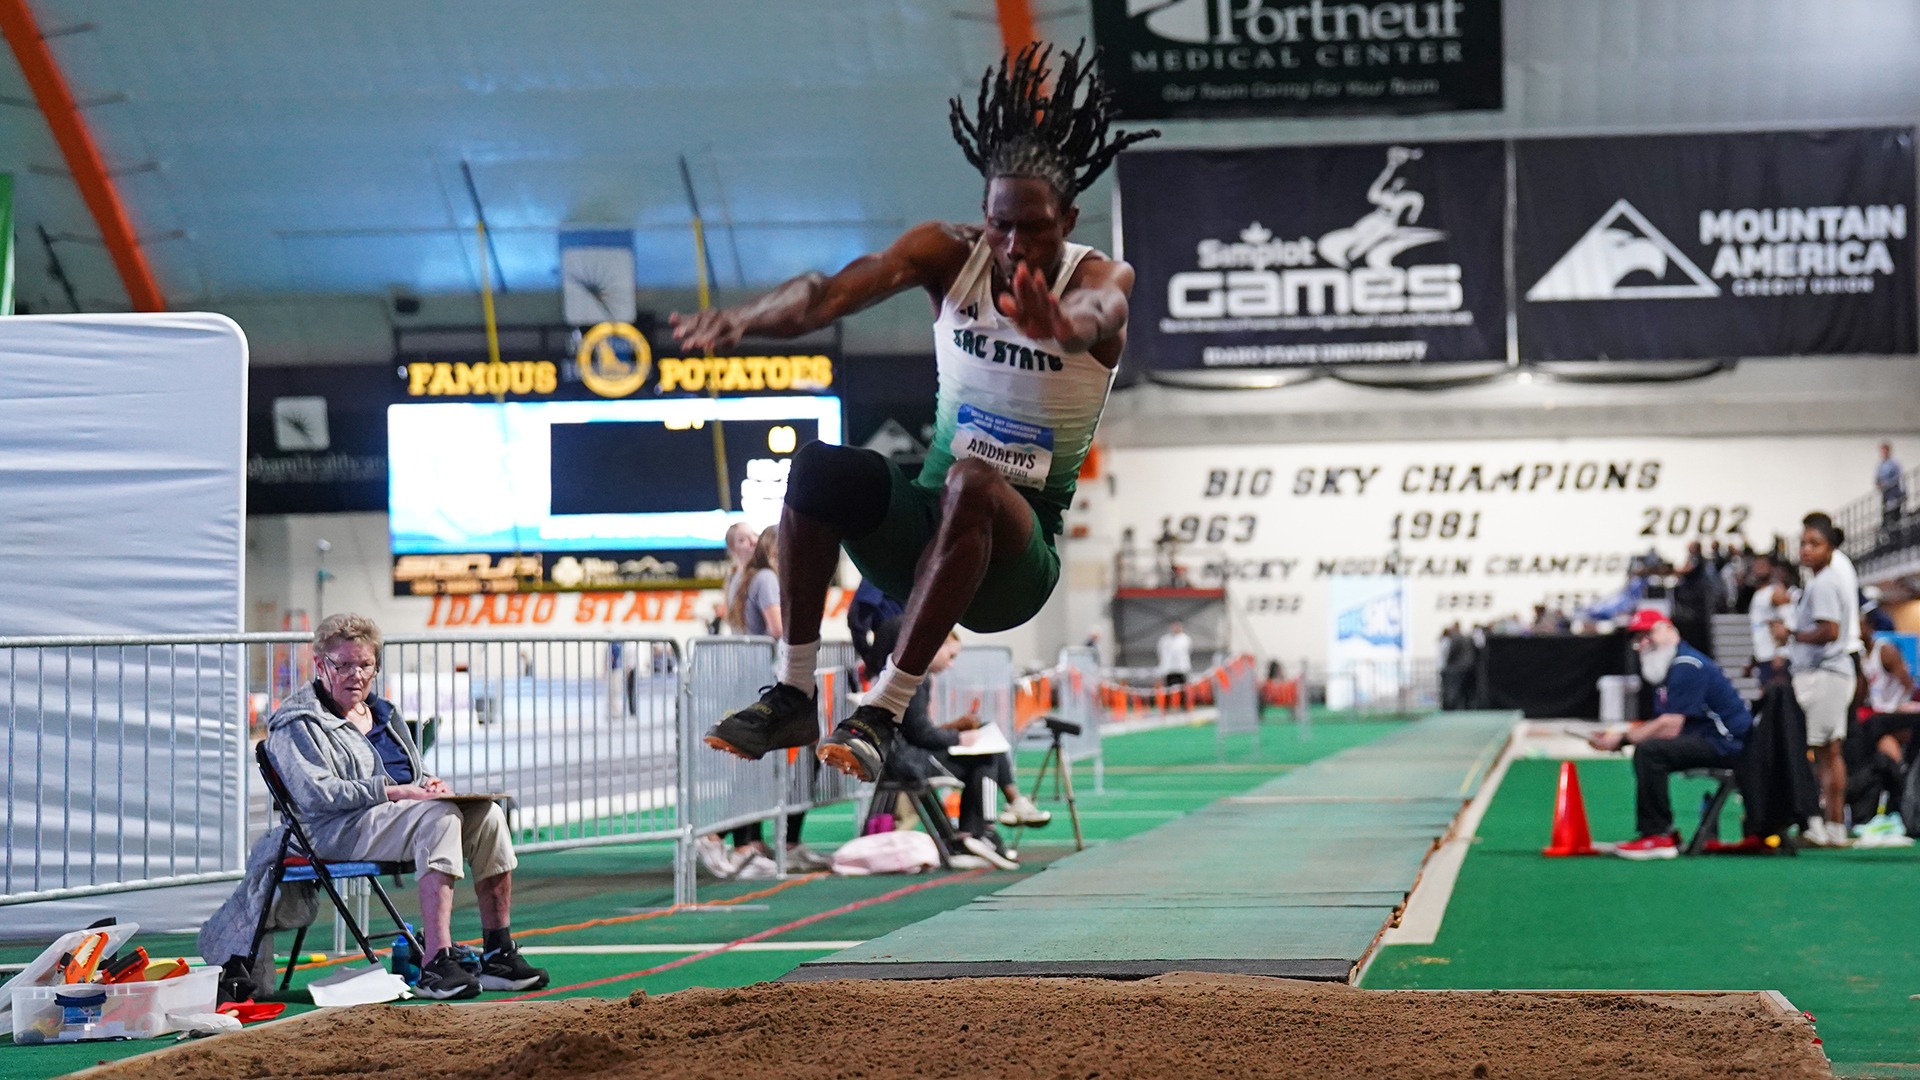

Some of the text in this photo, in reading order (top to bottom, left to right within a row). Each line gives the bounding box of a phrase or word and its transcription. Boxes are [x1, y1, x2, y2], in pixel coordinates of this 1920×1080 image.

[1130, 40, 1463, 73] MEDICAL CENTER
[1700, 205, 1906, 245] MOUNTAIN
[1197, 236, 1317, 271] Simplot
[1711, 240, 1895, 278] AMERICA
[1732, 275, 1875, 298] CREDIT UNION
[952, 329, 989, 359] SAC
[408, 355, 834, 396] FAMOUS POTATOES
[966, 438, 1036, 470] ANDREWS
[1204, 460, 1662, 499] BIG SKY CHAMPIONS
[1160, 504, 1751, 544] 1963 1981 2002
[1313, 555, 1472, 579] MOUNTAIN
[1485, 554, 1628, 577] CHAMPIO
[426, 589, 700, 627] IDAHO STATE
